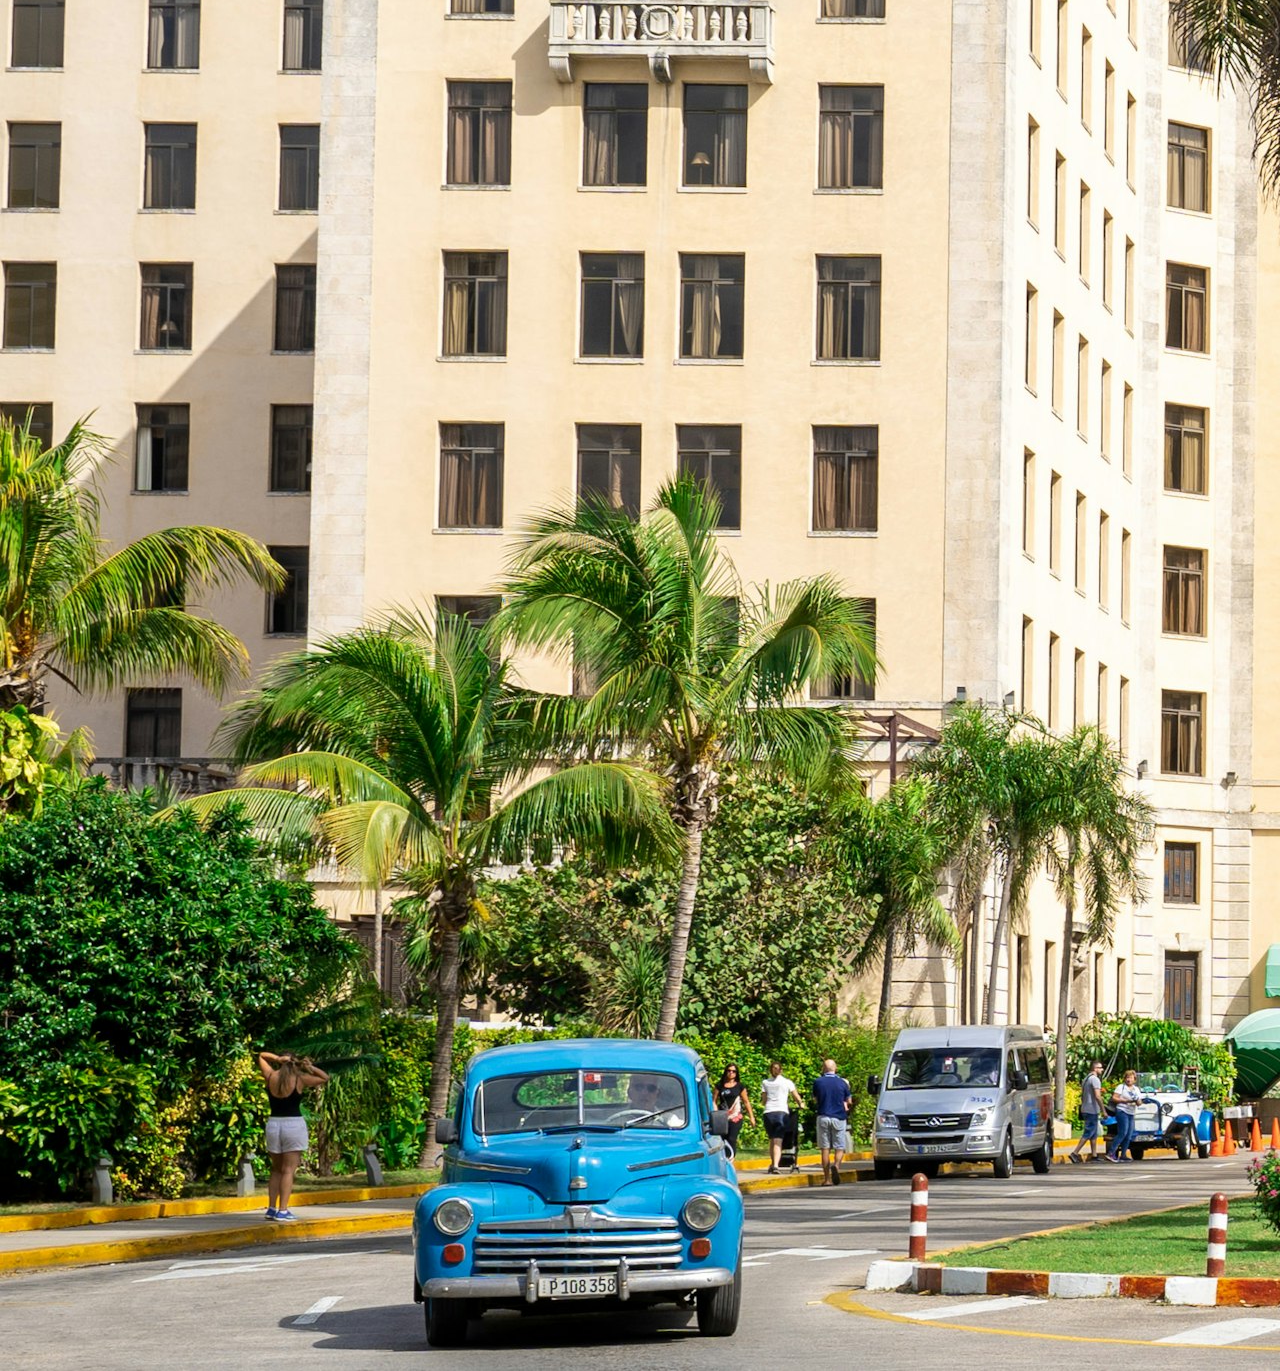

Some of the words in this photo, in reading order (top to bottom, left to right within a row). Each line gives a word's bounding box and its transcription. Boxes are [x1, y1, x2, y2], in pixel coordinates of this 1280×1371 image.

[550, 1280, 558, 1294] P
[561, 1279, 586, 1294] 108
[589, 1278, 615, 1292] 358
